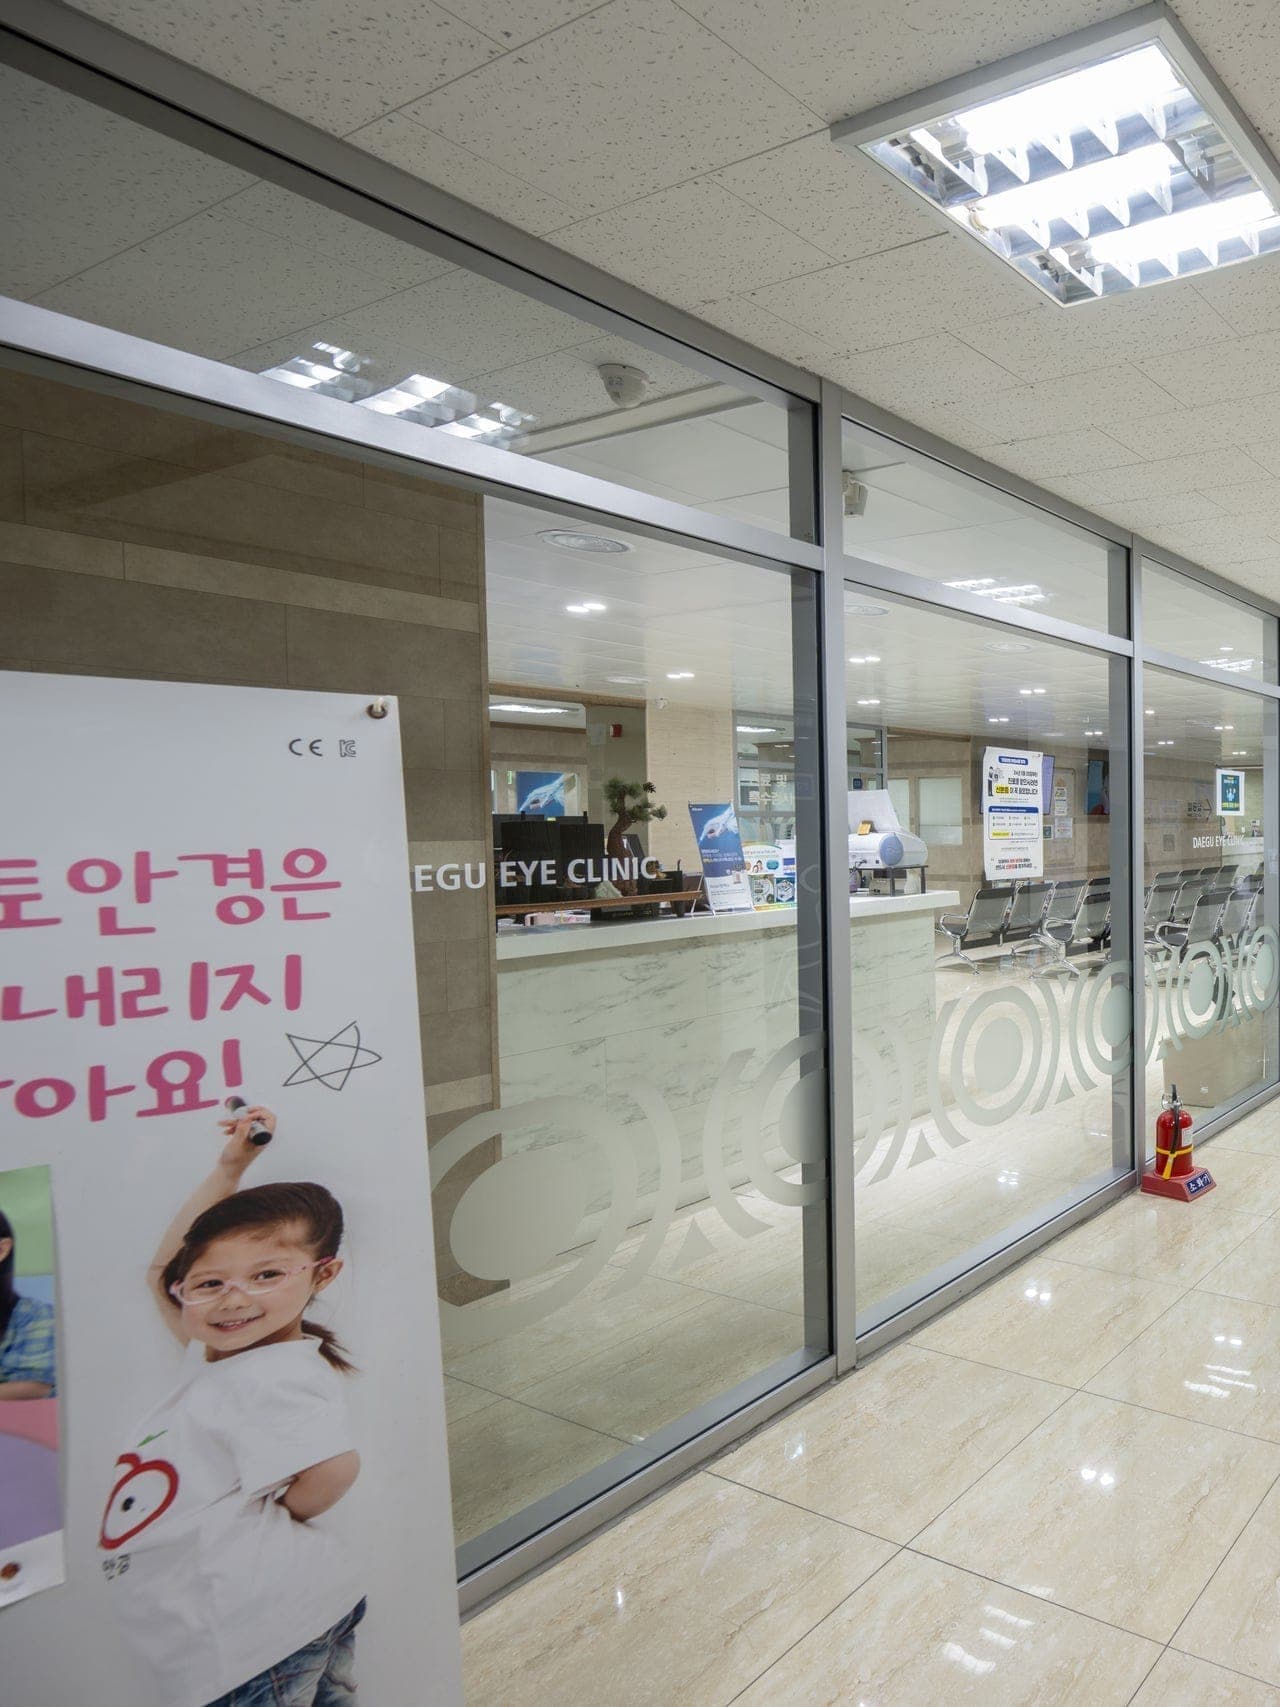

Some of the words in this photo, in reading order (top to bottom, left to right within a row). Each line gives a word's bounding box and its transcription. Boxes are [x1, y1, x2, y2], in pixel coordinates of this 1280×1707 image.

[289, 738, 323, 757] CE
[1193, 835, 1214, 848] DAEGU
[1216, 835, 1225, 847] EYE
[409, 862, 486, 892] EGU
[500, 859, 557, 888] EYE
[567, 856, 658, 884] CLINIC
[0, 1039, 243, 1122] 아요!
